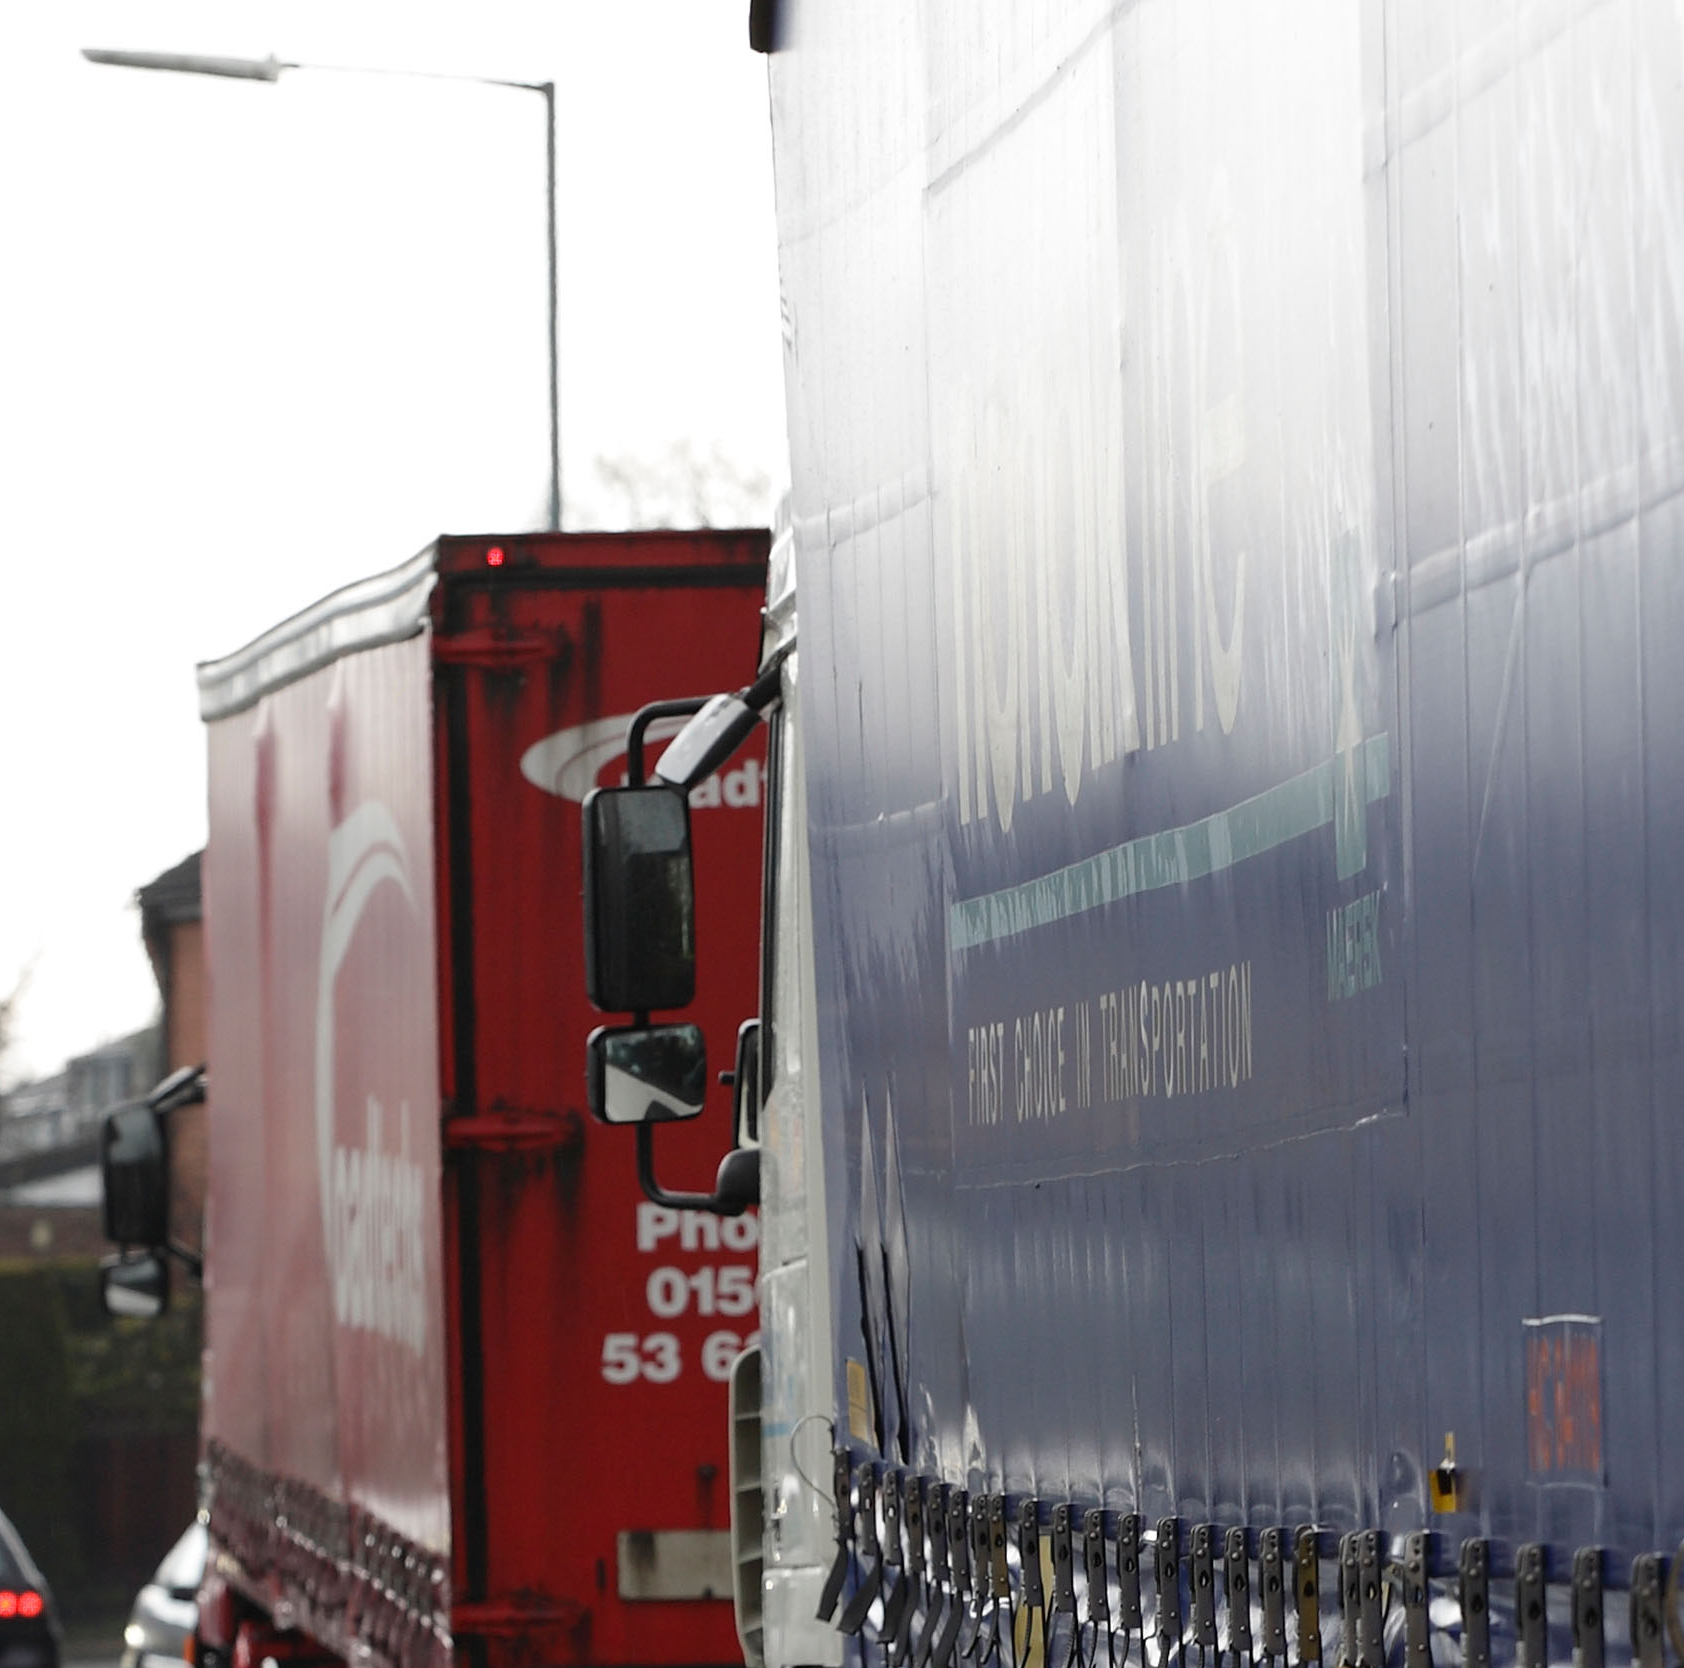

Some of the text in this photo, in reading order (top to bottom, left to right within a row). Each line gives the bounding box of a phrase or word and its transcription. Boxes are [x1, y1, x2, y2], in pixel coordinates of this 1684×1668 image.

[1325, 889, 1382, 1000] MAERSK
[967, 959, 1253, 1126] FIRST CHOICE IN TRANSPORTATION
[636, 1201, 758, 1251] Pho
[646, 1265, 760, 1319] 015
[601, 1331, 681, 1385] 53
